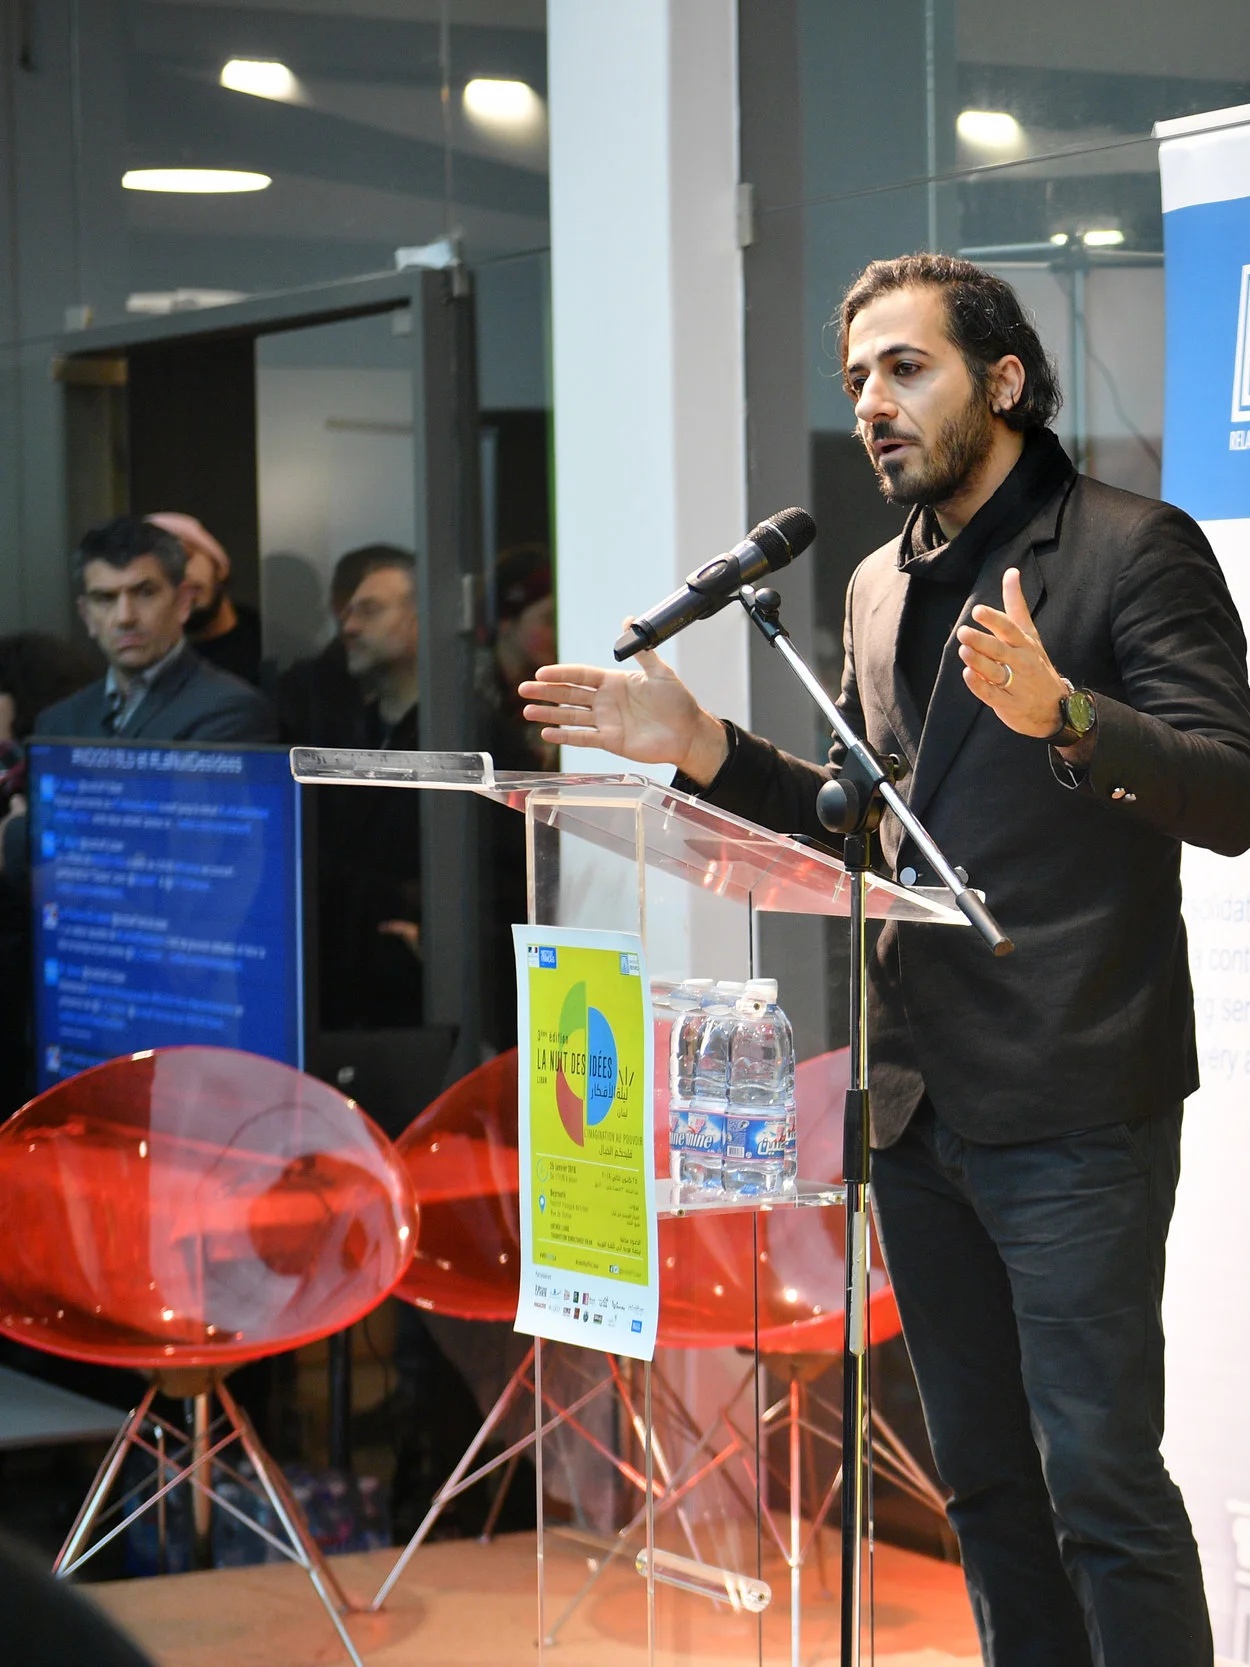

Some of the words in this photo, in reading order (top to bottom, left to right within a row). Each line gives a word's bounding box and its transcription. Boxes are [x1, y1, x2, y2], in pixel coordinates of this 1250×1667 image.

[537, 1048, 546, 1070] LA
[550, 1050, 568, 1073] NUIT
[571, 1052, 586, 1075] DES
[589, 1050, 613, 1079] IDÉES
